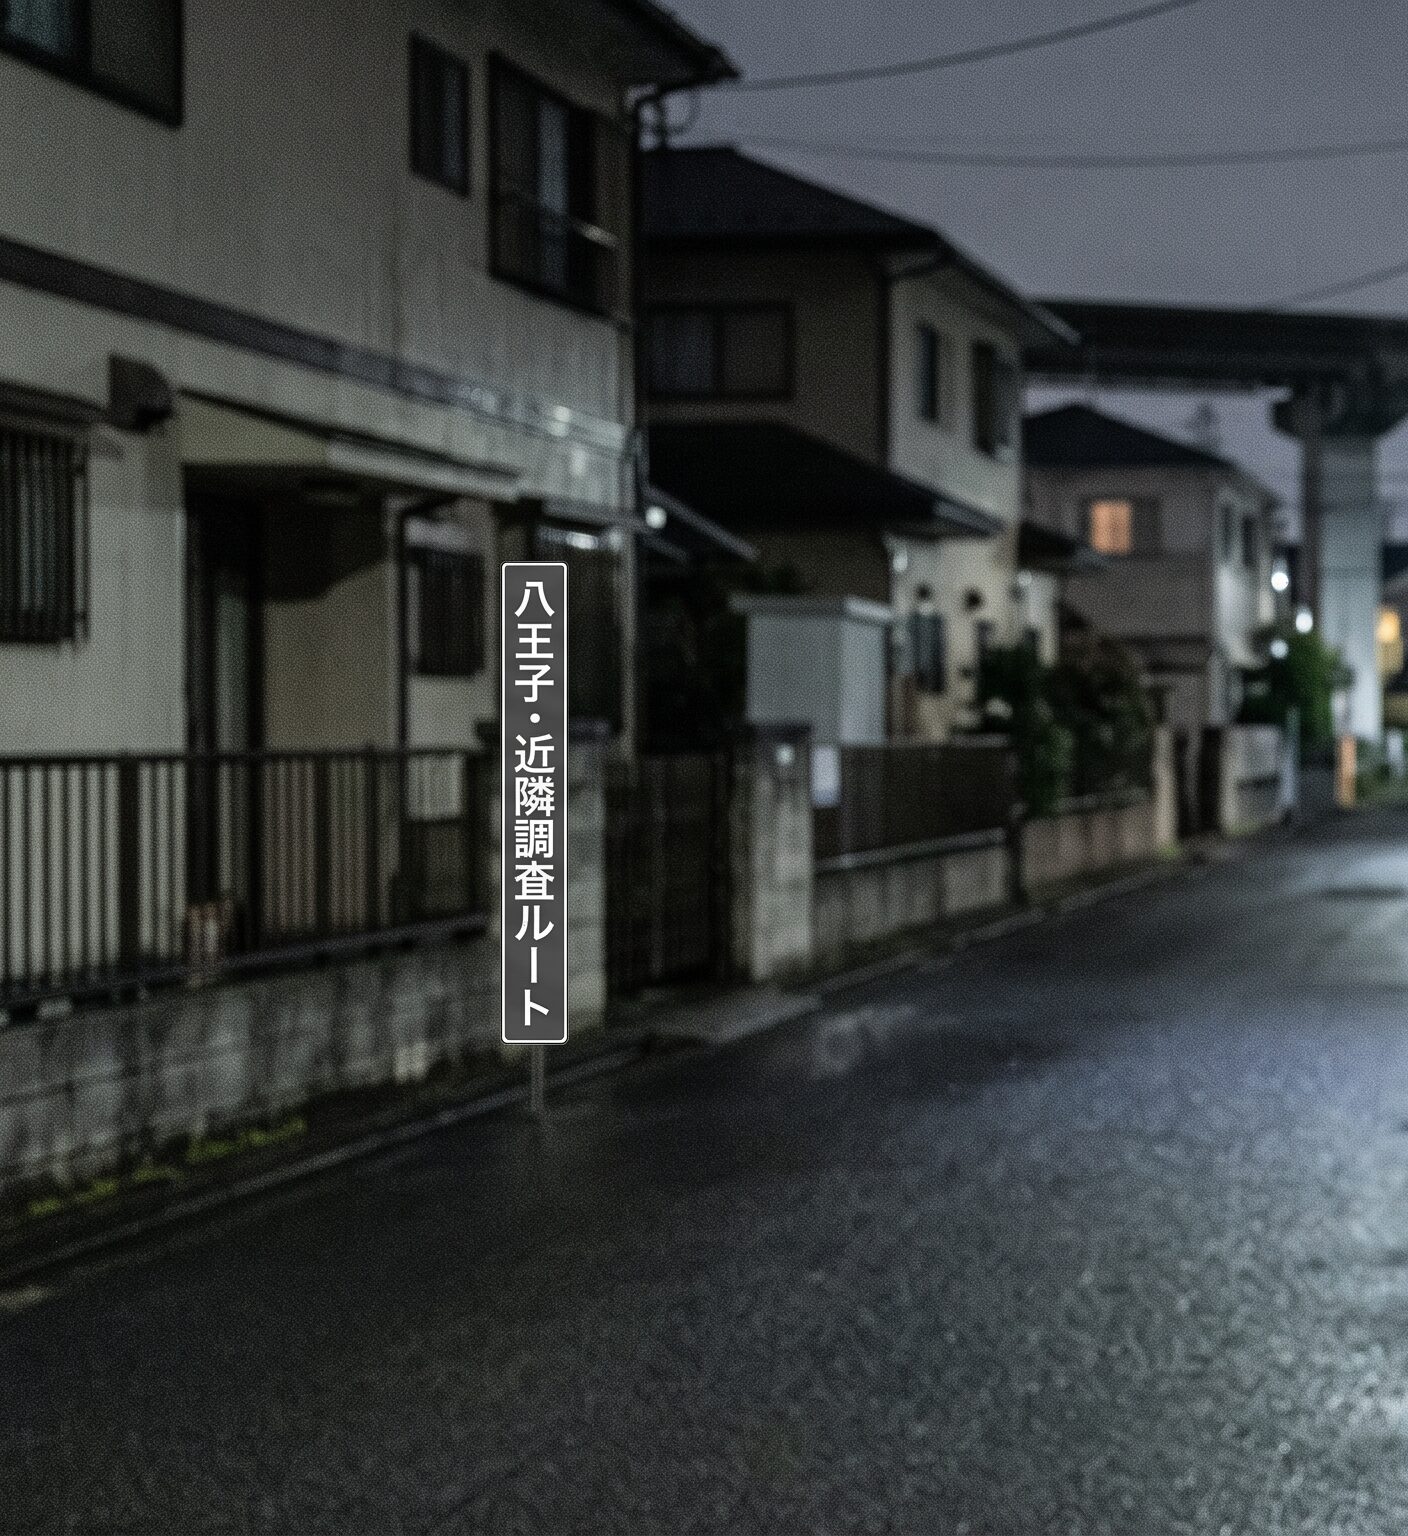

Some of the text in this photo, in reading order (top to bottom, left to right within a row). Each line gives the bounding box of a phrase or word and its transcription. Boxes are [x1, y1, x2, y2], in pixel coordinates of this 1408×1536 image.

[514, 581, 556, 1026] 八王子・近隣調査ルート
